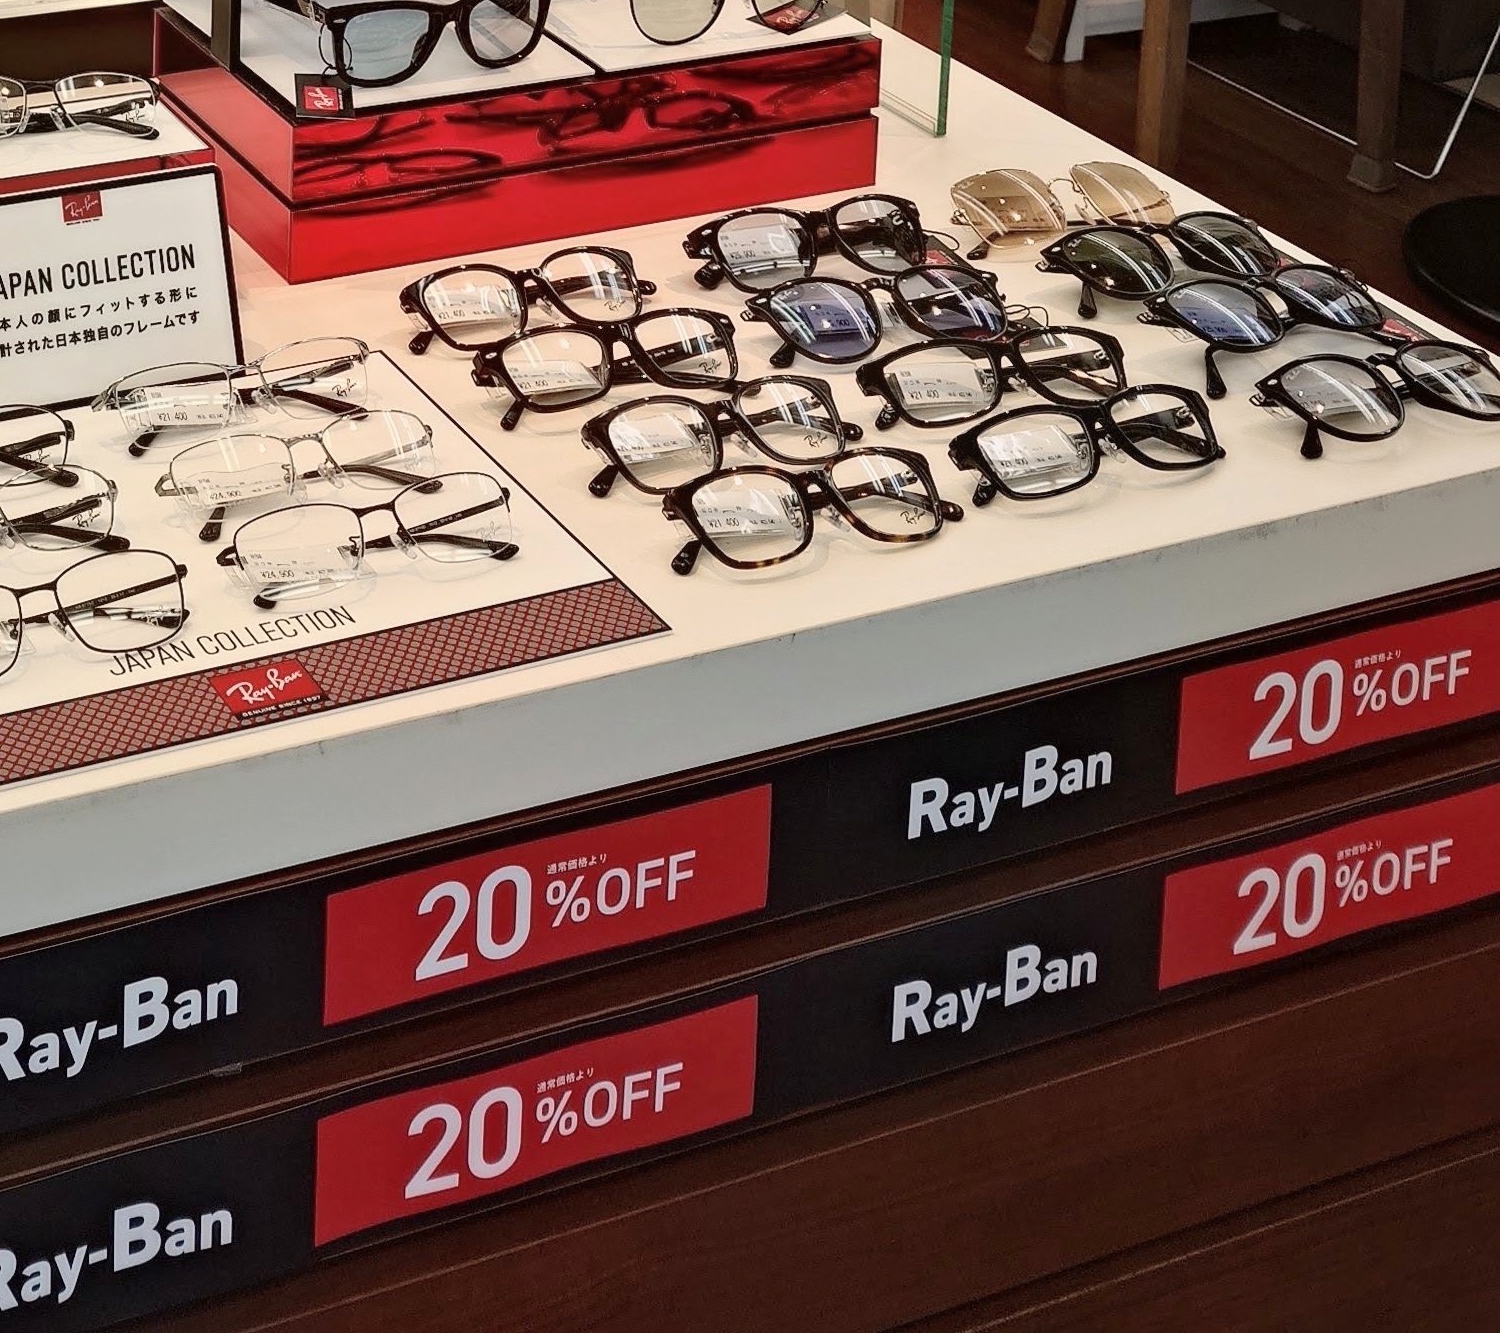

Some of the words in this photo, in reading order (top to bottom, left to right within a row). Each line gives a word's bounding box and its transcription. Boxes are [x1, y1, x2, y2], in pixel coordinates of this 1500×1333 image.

[65, 194, 99, 218] Ray-Ban
[61, 243, 196, 291] COLLECTION
[109, 639, 195, 676] JAPAN
[196, 605, 357, 656] COLLECTION
[225, 668, 303, 705] Ray-Ban
[278, 699, 302, 711] SINCE
[1248, 650, 1473, 761] 20%OFF
[907, 745, 1112, 840] Ray-Ban
[547, 853, 607, 875] 通常価格より
[1233, 838, 1454, 955] 20%OFF
[415, 850, 697, 982] 20%OFF
[891, 944, 1098, 1043] Ray-Ban
[537, 1067, 595, 1093] 通常価格より
[405, 1063, 684, 1200] 20%OFF
